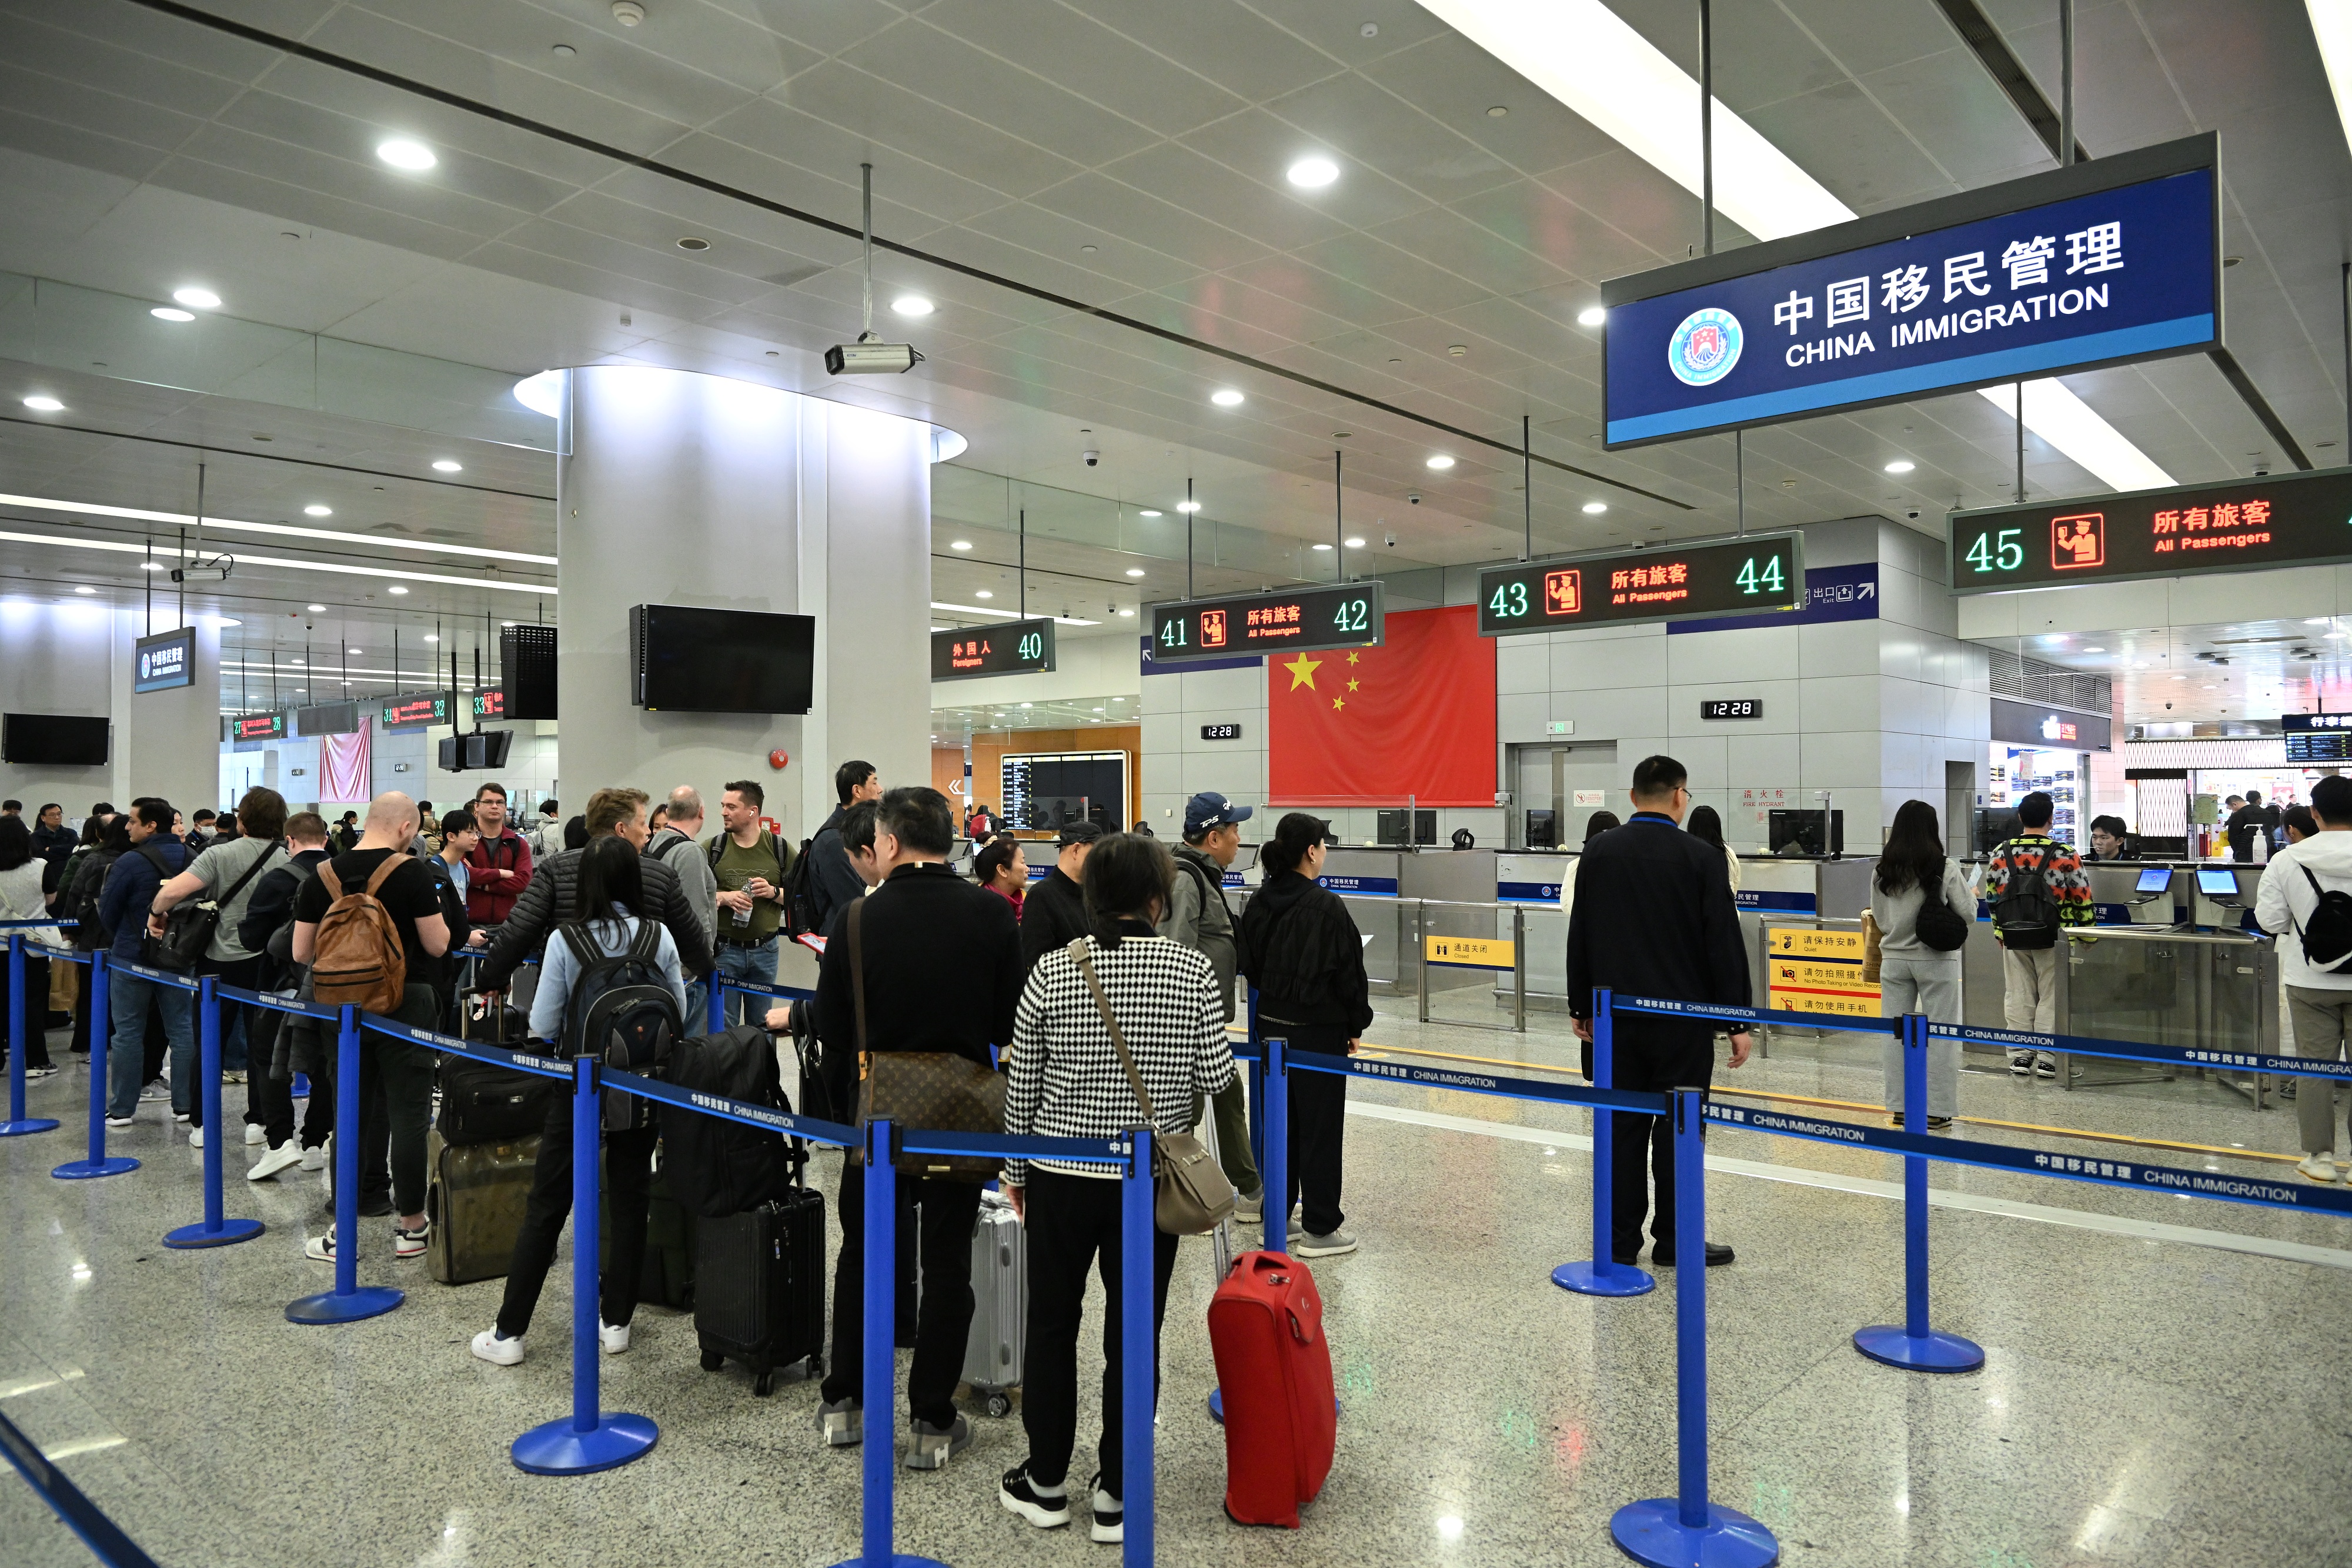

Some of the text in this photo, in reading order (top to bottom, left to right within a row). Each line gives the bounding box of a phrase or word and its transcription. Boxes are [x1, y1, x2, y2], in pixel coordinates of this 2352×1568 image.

[1774, 221, 2124, 336] 中国移民管理
[1786, 283, 2109, 367] CHINA IMMIGRATION
[2153, 500, 2271, 534] 所有旅客
[1965, 529, 2022, 572] 45
[2154, 531, 2271, 553] All Passengers
[1611, 563, 1687, 590] 所有旅客
[1736, 554, 1785, 594] 44
[1489, 582, 1528, 617] 43
[1613, 588, 1687, 604] All Passengers
[1814, 587, 1835, 598] 出口
[1247, 605, 1301, 626] 所有旅客
[1334, 599, 1367, 632] 42
[1161, 618, 1187, 647] 41
[1248, 626, 1301, 638] All Passengers
[953, 640, 991, 656] 外国人
[1018, 633, 1041, 659] 40
[152, 647, 183, 666] 中国移民管理
[953, 658, 983, 667] Foreigners
[435, 700, 444, 717] 32
[474, 697, 484, 714] 33
[273, 716, 281, 730] 28
[383, 708, 392, 722] 31
[234, 721, 241, 734] 27
[1744, 790, 1784, 798] 消火栓
[1454, 943, 1487, 953] 通道关闭
[1803, 935, 1857, 947] 请保持安静
[1636, 999, 1681, 1010] 中国移民管理
[1687, 1004, 1756, 1017] CHINA IMMIGRATION
[1805, 999, 1867, 1013] 请勿使用手机
[1929, 1025, 1958, 1036] 民管理
[1965, 1029, 2054, 1047] CHINA IMMIGRATION
[2186, 1051, 2257, 1066] 中国移民管理
[2267, 1059, 2352, 1075] CHINA IMMIGRA
[1354, 1061, 1407, 1078] 中国移民管理
[1414, 1070, 1439, 1082] CHINA
[734, 1105, 794, 1128] CHINA IMMIGRATION
[1753, 1114, 1865, 1141] CHINA IMMIGRATION
[2036, 1154, 2132, 1179] 中国移民管理
[2144, 1170, 2297, 1202] CHINA IMMIGRATION
